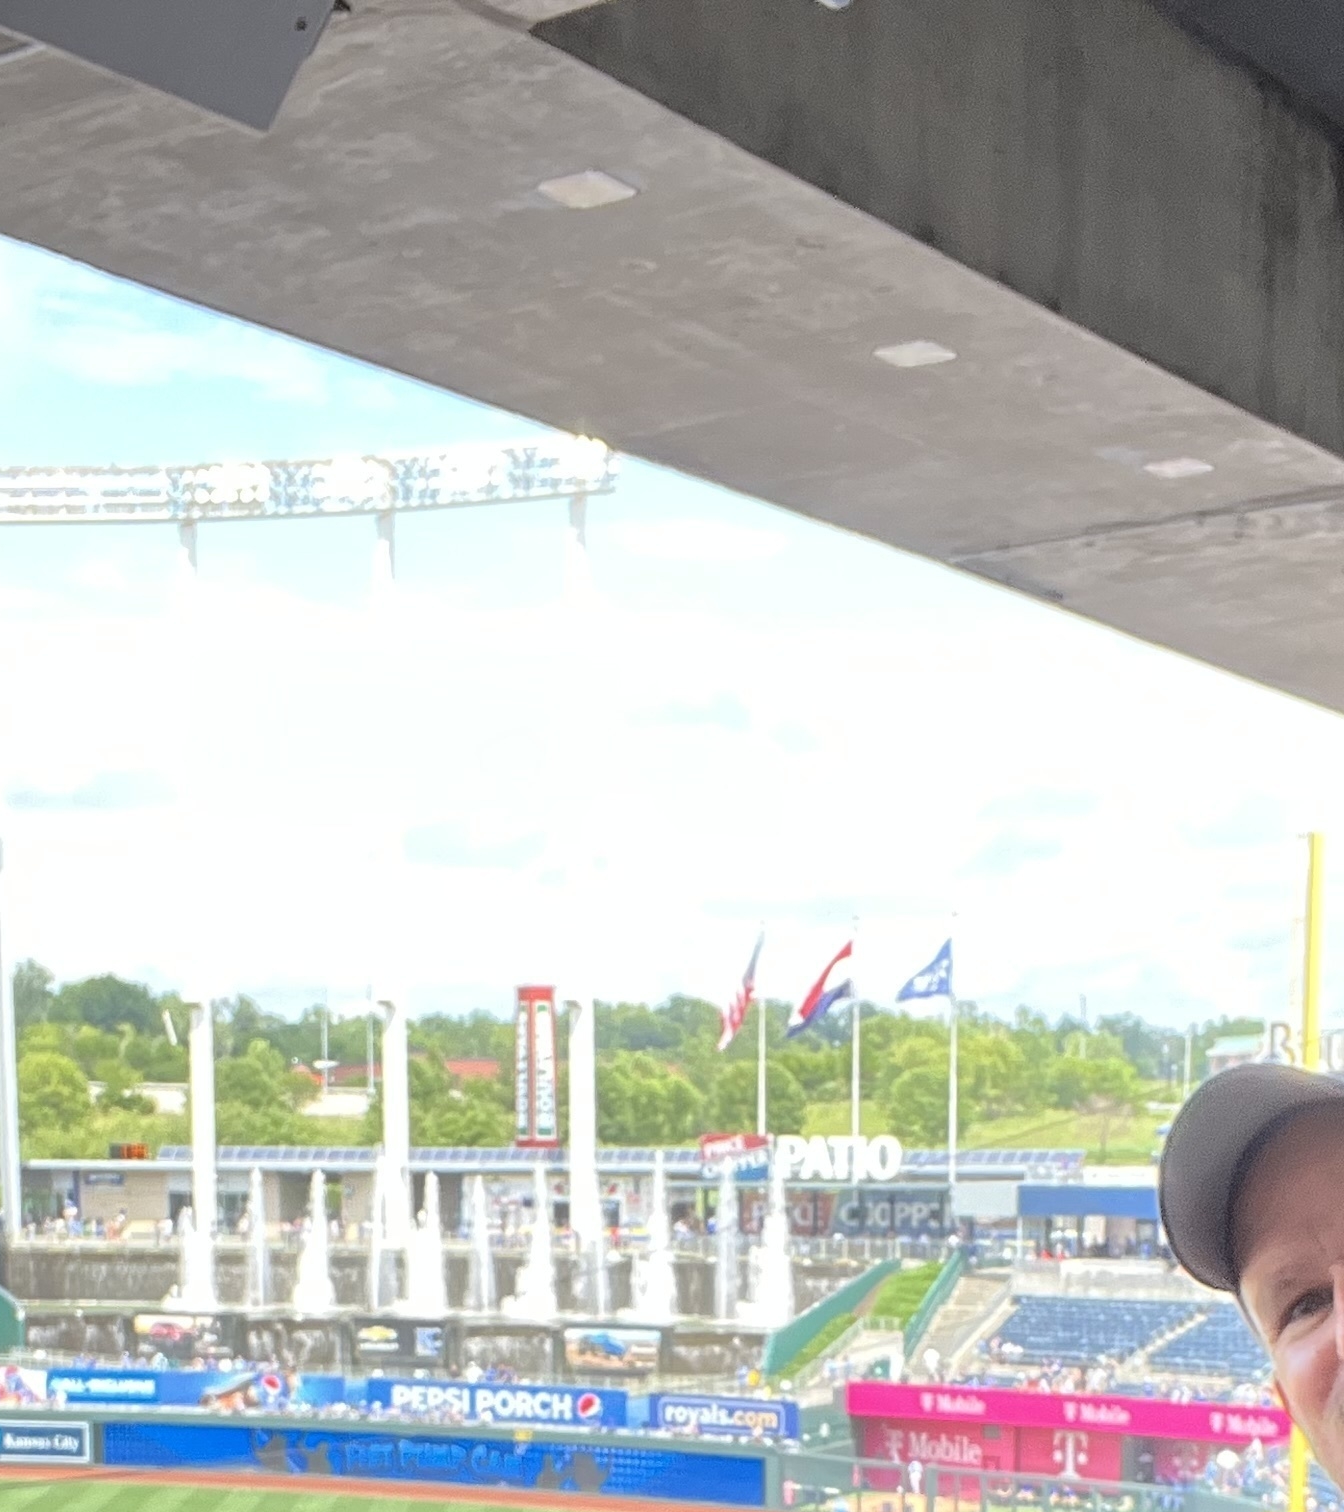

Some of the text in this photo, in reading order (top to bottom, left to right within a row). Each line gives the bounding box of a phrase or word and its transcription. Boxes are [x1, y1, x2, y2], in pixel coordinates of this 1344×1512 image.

[775, 1135, 903, 1181] PATIO
[391, 1385, 573, 1421] PEPSI PORCH
[664, 1403, 778, 1429] royals.com
[908, 1431, 984, 1465] Mobile
